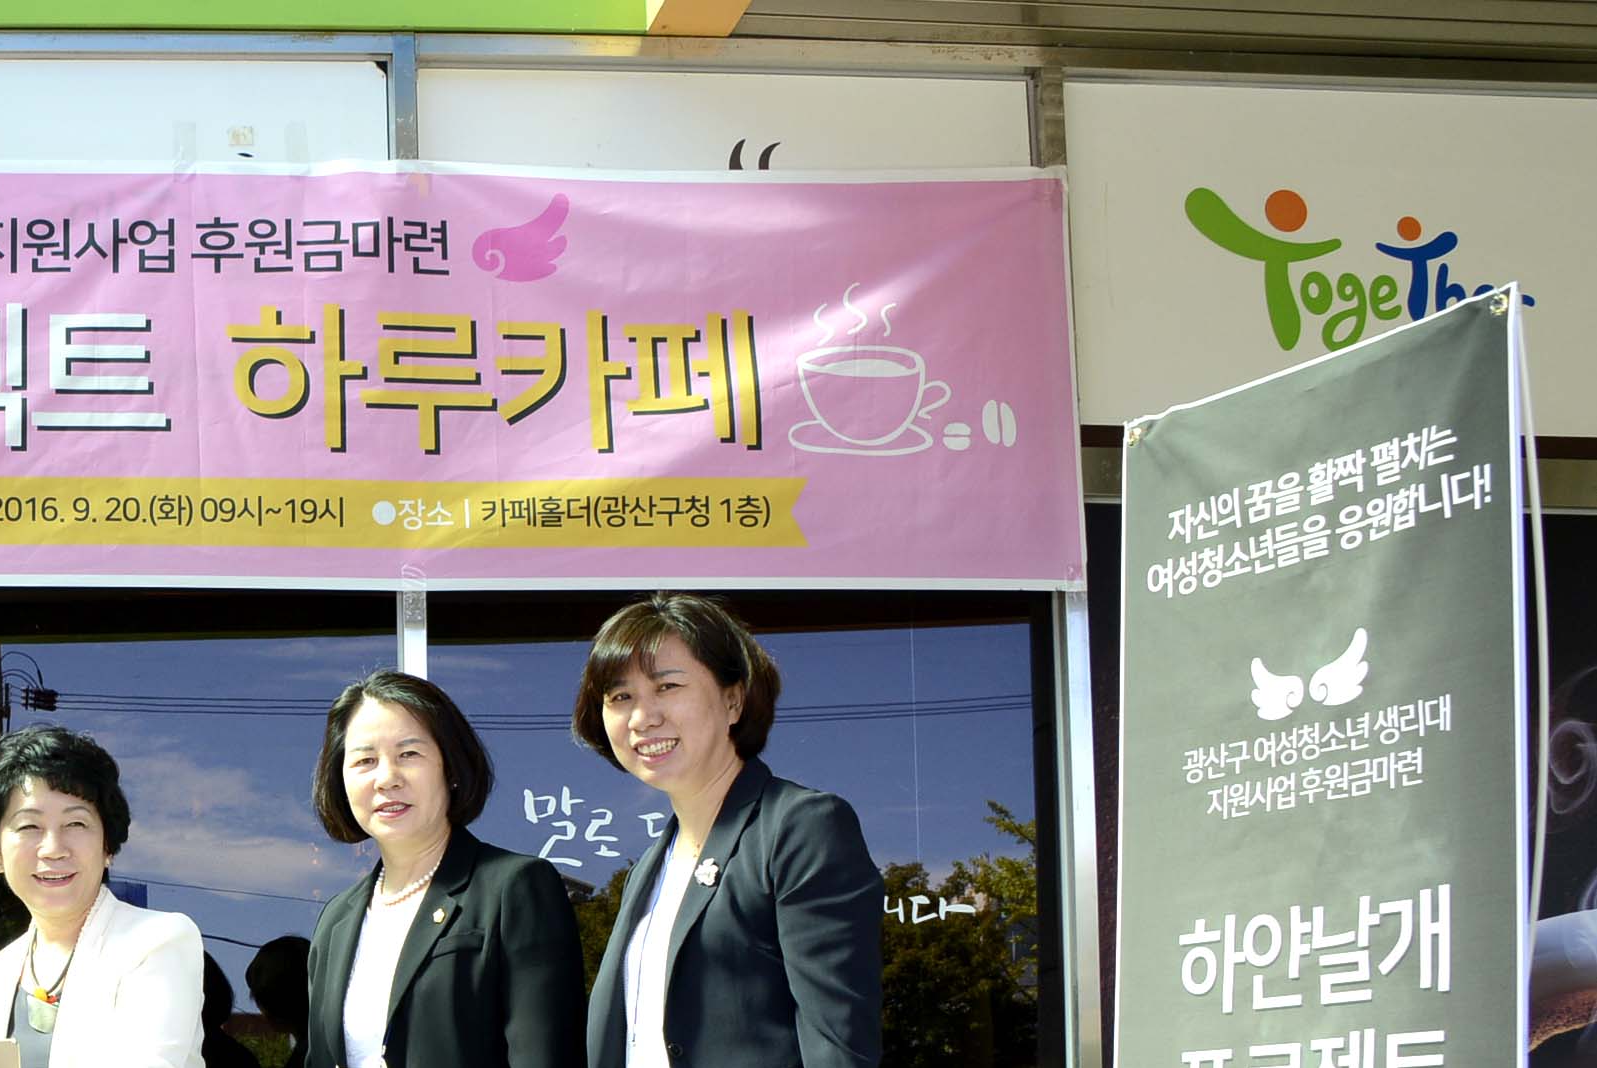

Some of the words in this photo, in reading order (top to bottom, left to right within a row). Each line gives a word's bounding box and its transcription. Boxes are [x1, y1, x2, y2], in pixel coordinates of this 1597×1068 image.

[192, 217, 450, 276] 후원금마련
[1184, 187, 1535, 352] TogeTh
[225, 303, 763, 454] 하루카페
[72, 496, 98, 524] 9.
[105, 494, 194, 527] 20.(화)
[200, 495, 346, 526] 09시~19시
[398, 496, 455, 528] 장소
[481, 494, 710, 529] 카페홀더(광산구청
[719, 494, 771, 529] 1층)
[1147, 516, 1333, 600] 여성청소년들을
[1336, 463, 1493, 548] 응원합니다!
[1167, 487, 1242, 545] 자신의
[1244, 471, 1305, 519] 꿈을
[1307, 450, 1365, 506] 활짝
[1370, 425, 1458, 482] 펼치는
[1183, 741, 1252, 785] 광산구
[1253, 711, 1371, 770] 여성청소년
[1373, 693, 1452, 744] 생리대
[1206, 774, 1297, 820] 지원사업
[1300, 747, 1424, 804] 후원금마련
[1178, 883, 1451, 1014] 하얀날개
